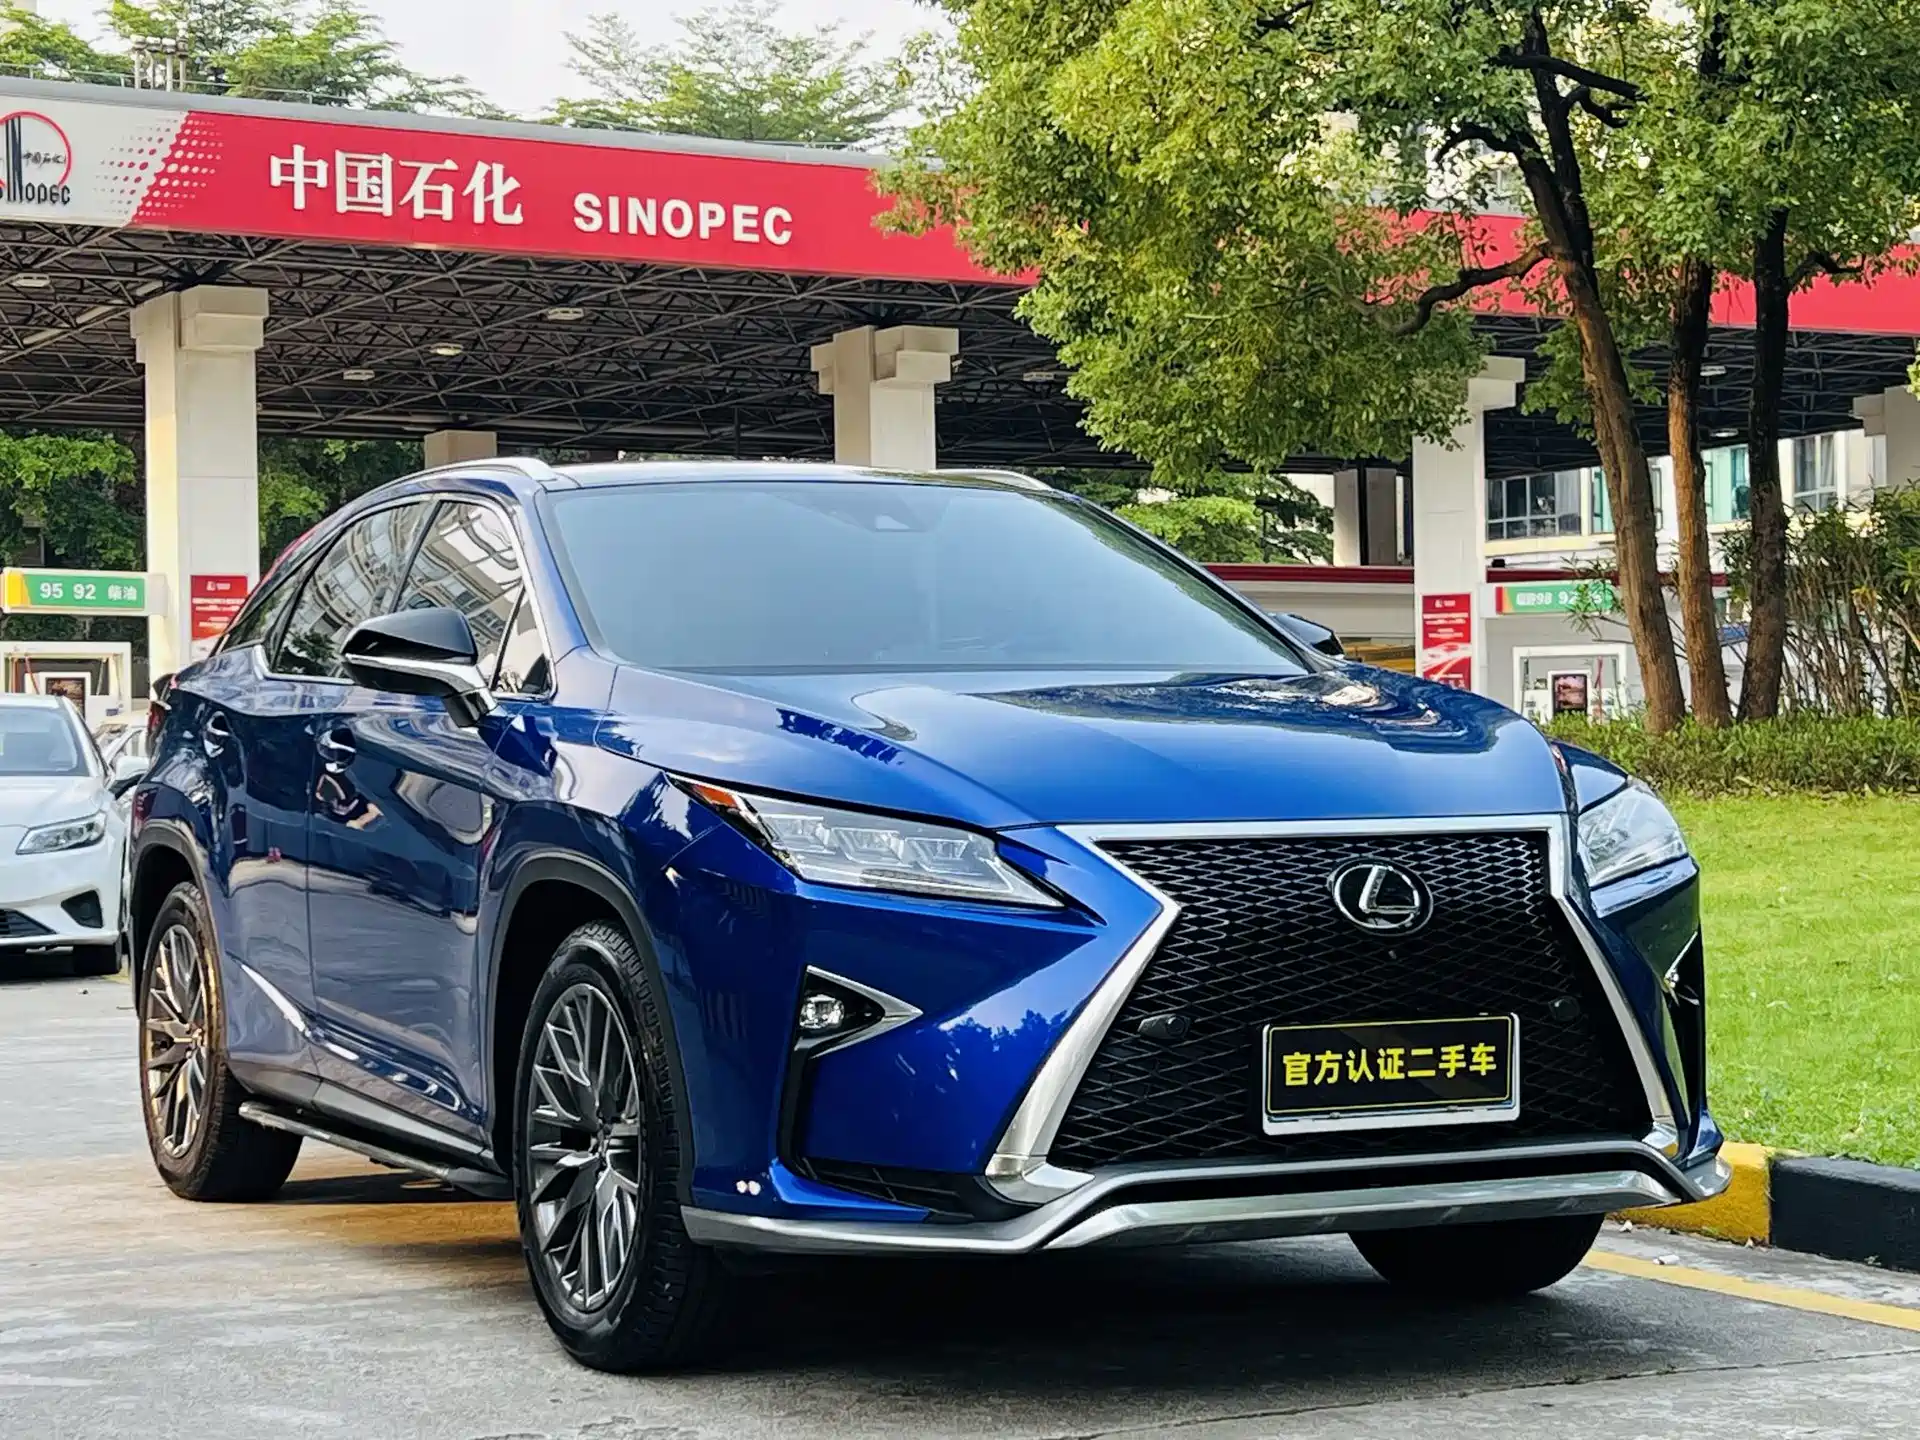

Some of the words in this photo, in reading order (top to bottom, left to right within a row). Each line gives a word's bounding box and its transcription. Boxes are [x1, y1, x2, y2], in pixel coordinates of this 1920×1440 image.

[270, 144, 524, 225] 中国石化
[573, 192, 793, 245] SINOPEC
[40, 582, 63, 599] 95
[73, 583, 97, 600] 92
[1283, 1043, 1497, 1086] 官方认证二手车
